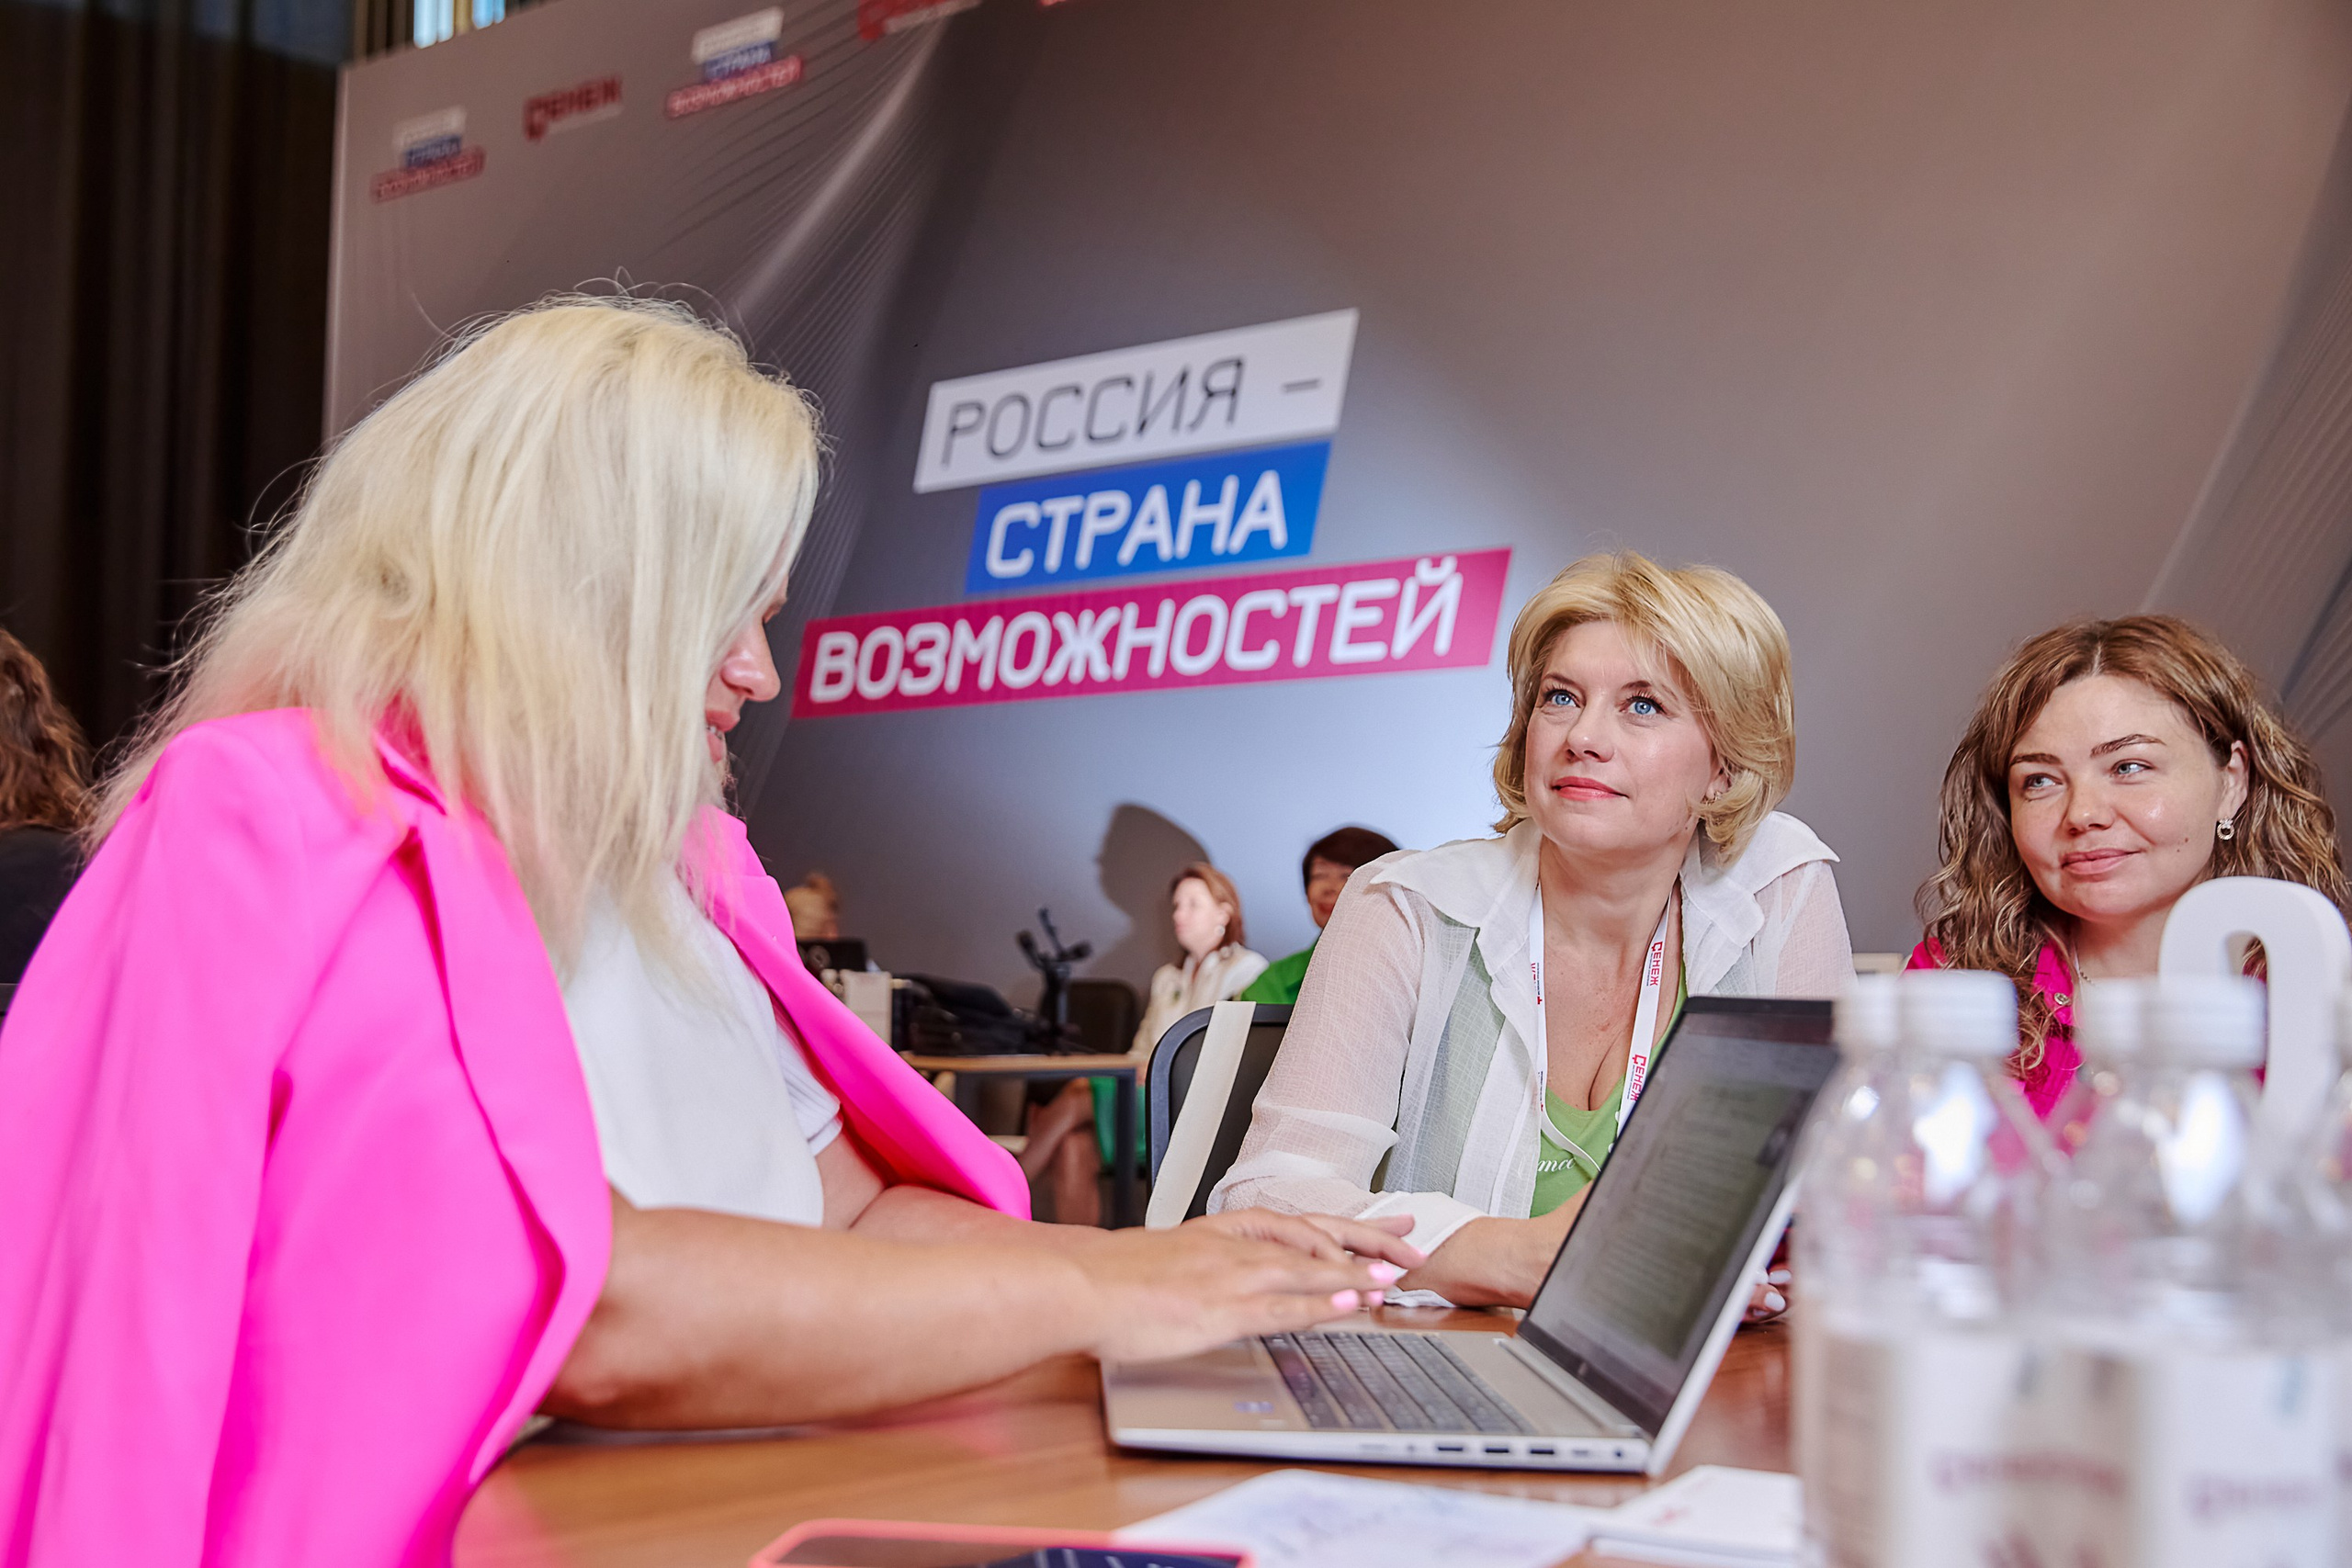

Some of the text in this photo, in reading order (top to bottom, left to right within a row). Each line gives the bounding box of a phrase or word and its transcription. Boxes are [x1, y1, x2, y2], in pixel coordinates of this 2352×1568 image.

[942, 355, 1245, 468] РОССИЯ
[985, 468, 1289, 579] СТРАНА
[808, 554, 1464, 705] ВОЗМОЖНОСТЕЙ
[1651, 941, 1663, 986] СЕНЕЖ
